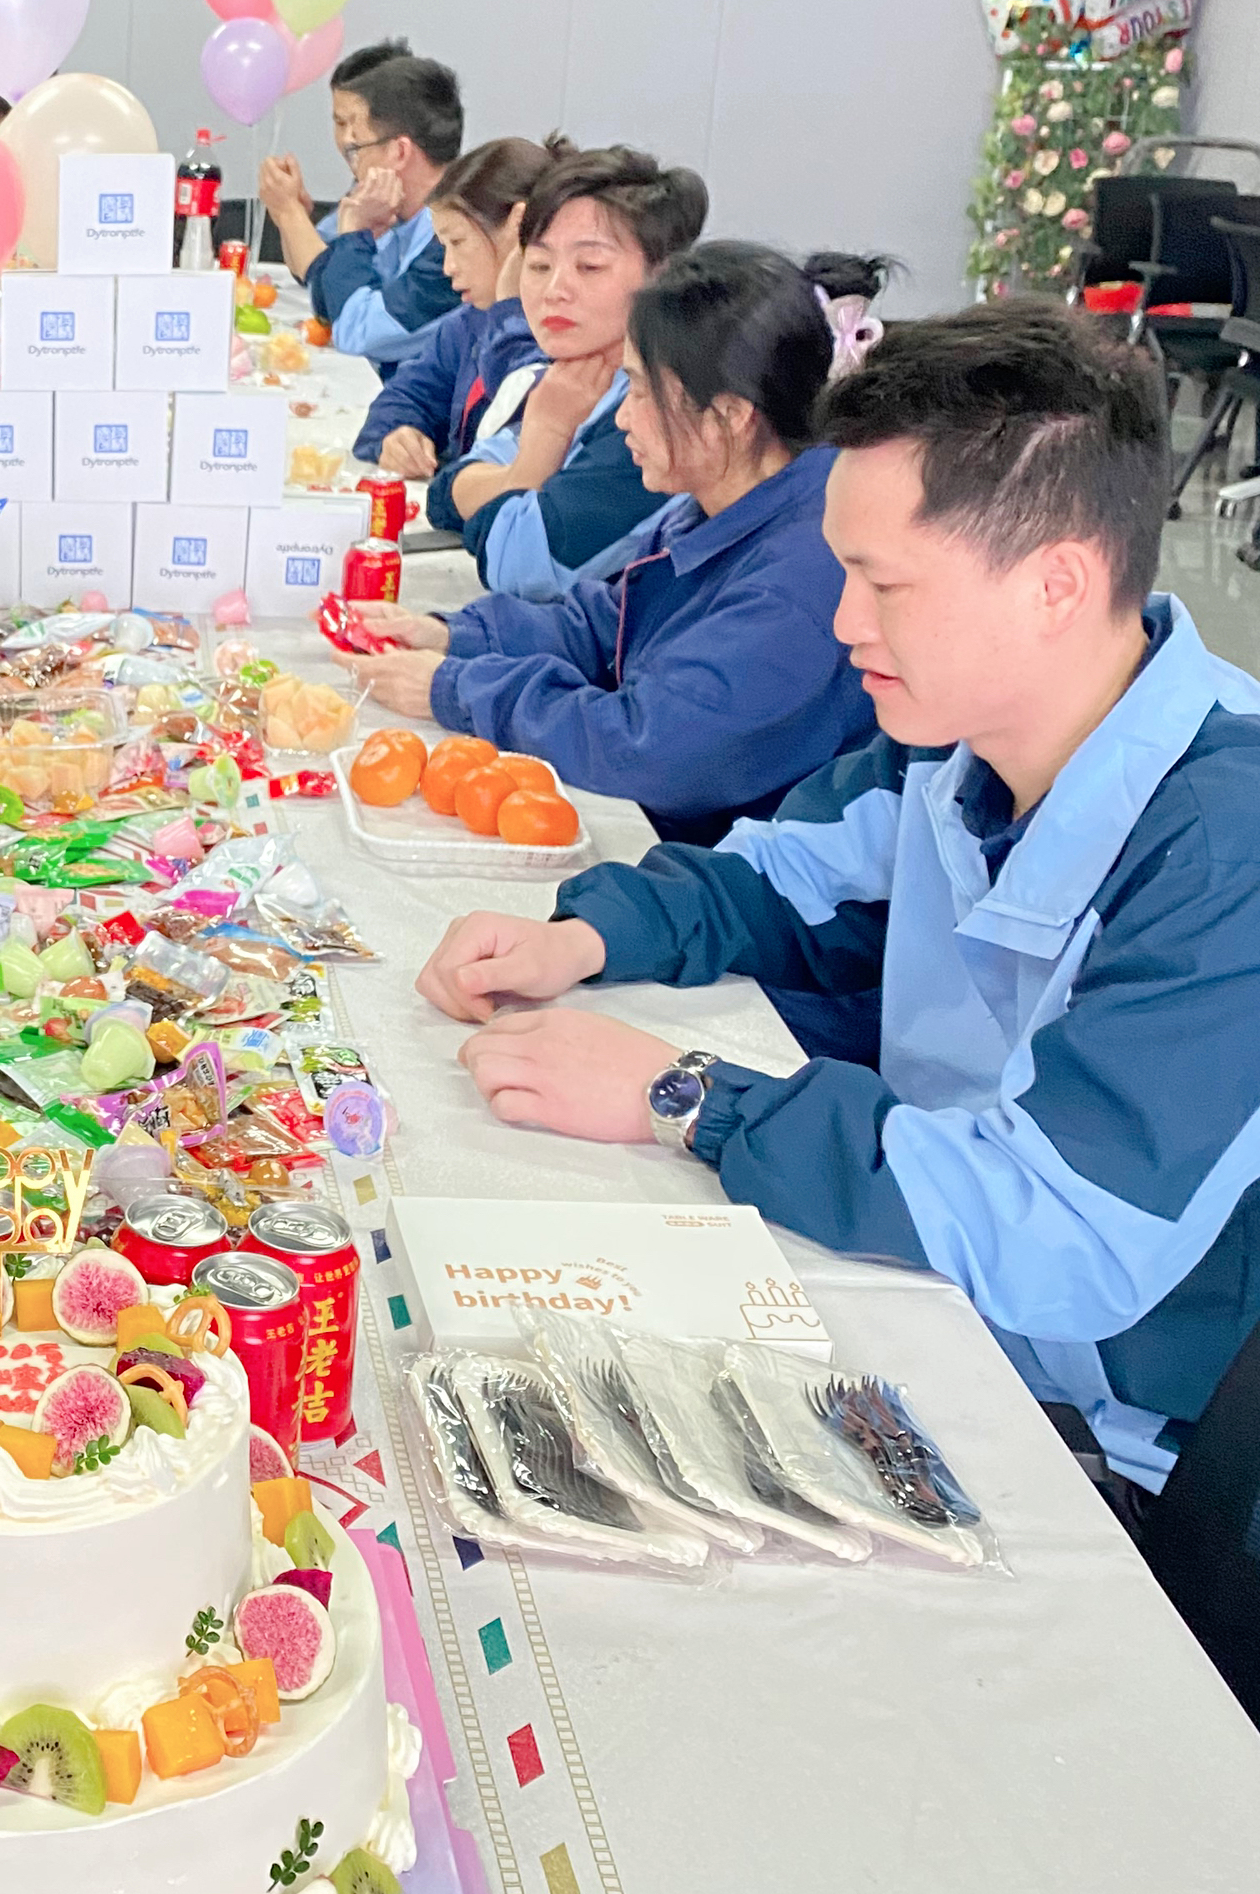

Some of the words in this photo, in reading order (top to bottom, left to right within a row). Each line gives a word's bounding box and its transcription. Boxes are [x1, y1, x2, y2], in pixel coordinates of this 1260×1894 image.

[444, 1263, 562, 1285] Happy
[595, 1257, 629, 1272] Best
[560, 1261, 610, 1276] wishes
[610, 1271, 626, 1282] to
[621, 1281, 643, 1298] you
[265, 1322, 295, 1340] 王老吉
[304, 1297, 340, 1424] 王老吉
